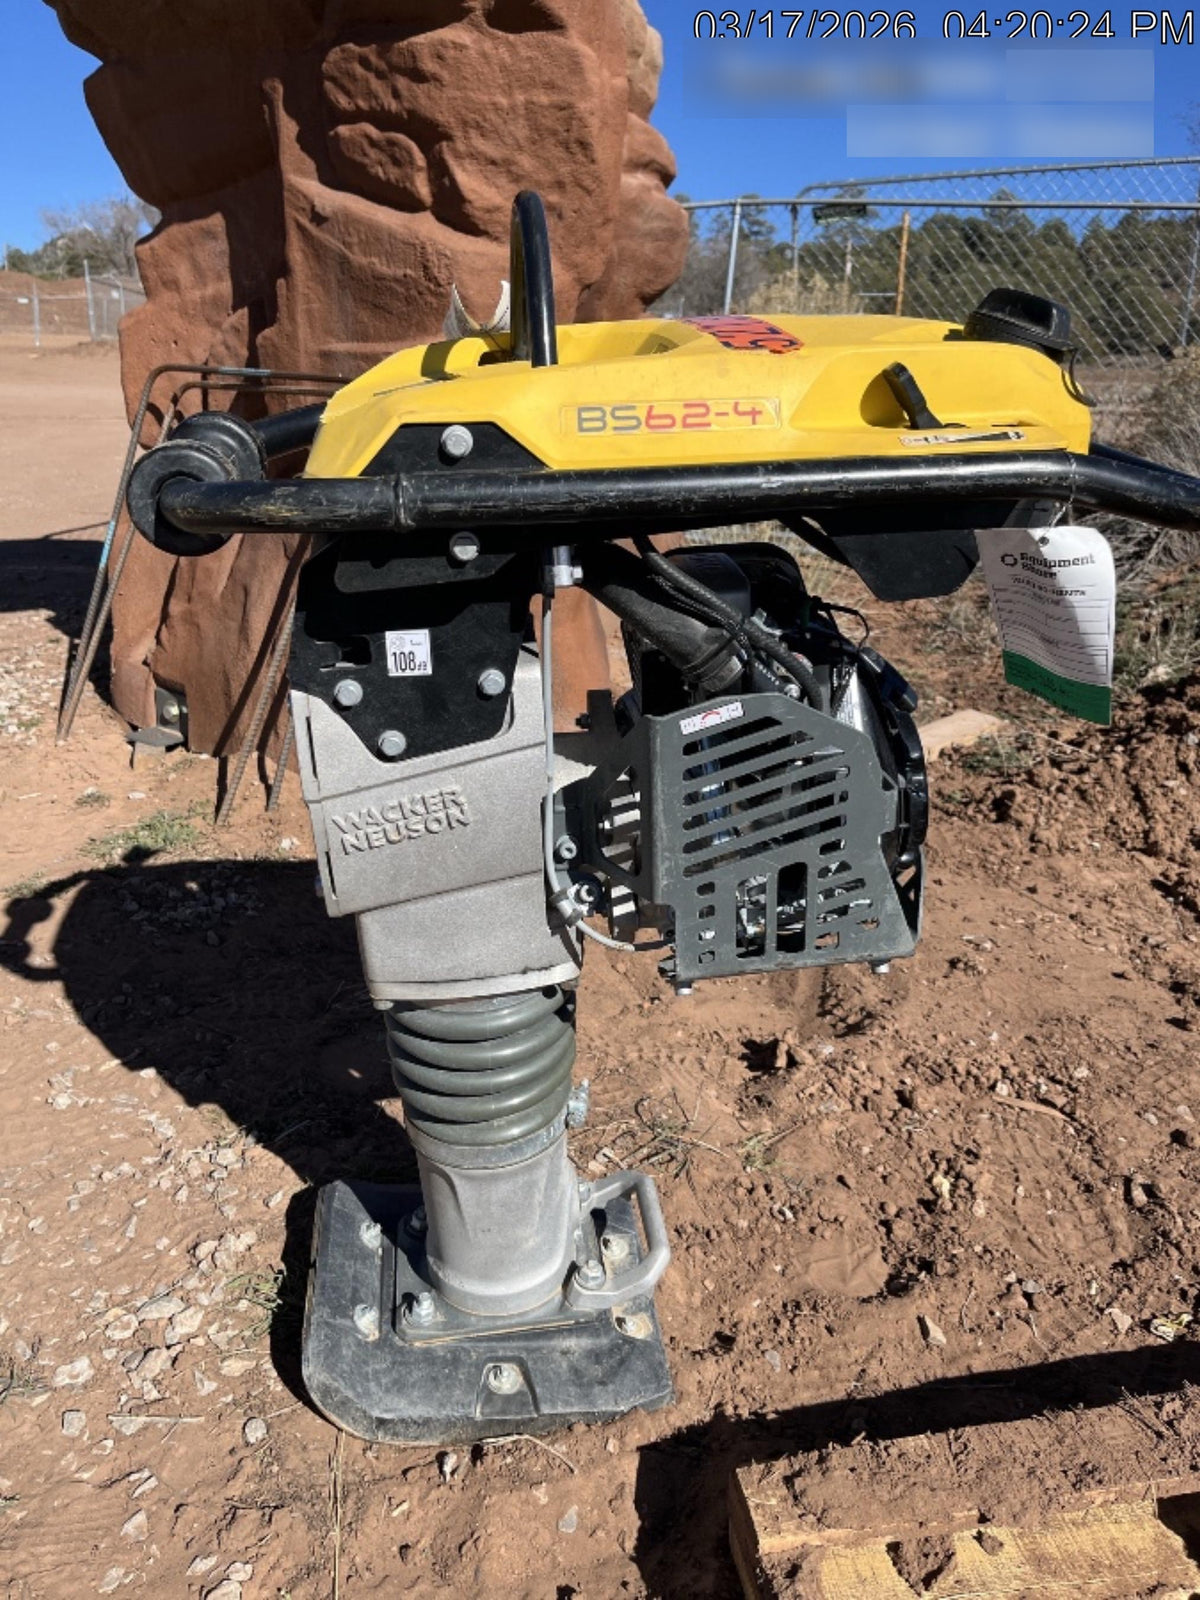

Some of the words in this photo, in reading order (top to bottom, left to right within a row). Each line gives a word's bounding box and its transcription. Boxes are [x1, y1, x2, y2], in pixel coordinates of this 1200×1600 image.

[577, 401, 763, 433] BS62-4
[1020, 552, 1096, 569] Equipment
[391, 651, 417, 673] 108
[331, 785, 467, 834] WACKER
[341, 810, 470, 855] NEUSON
